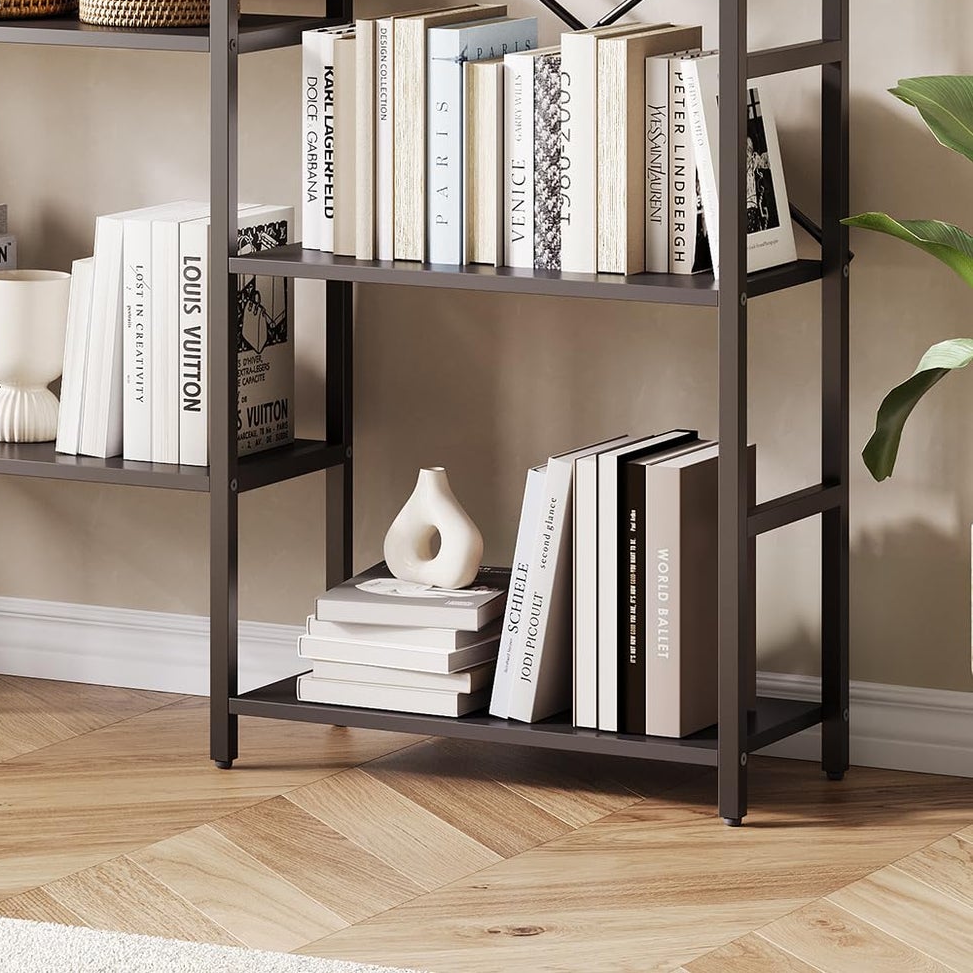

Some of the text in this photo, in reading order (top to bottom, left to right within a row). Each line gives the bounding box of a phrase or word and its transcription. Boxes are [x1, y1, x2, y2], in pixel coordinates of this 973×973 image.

[477, 39, 532, 60] PARIS
[306, 76, 318, 121] DOLCE
[380, 63, 388, 121] COLLECTION
[514, 108, 523, 142] GARRY
[306, 130, 318, 203] GABBANA
[323, 65, 334, 219] KARL LAGERFELD
[435, 101, 449, 226] PARIS
[674, 72, 685, 262] PETER LINDBERGH
[511, 159, 526, 243] VENICE
[135, 265, 144, 403] LOST IN CREATIVITY
[183, 256, 202, 412] LOUIS VUITTON
[246, 398, 288, 428] VUITTON
[507, 562, 530, 634] SCHIELE
[519, 497, 558, 683] JODI PICOULT second glance
[657, 548, 670, 659] WORLD BALLET
